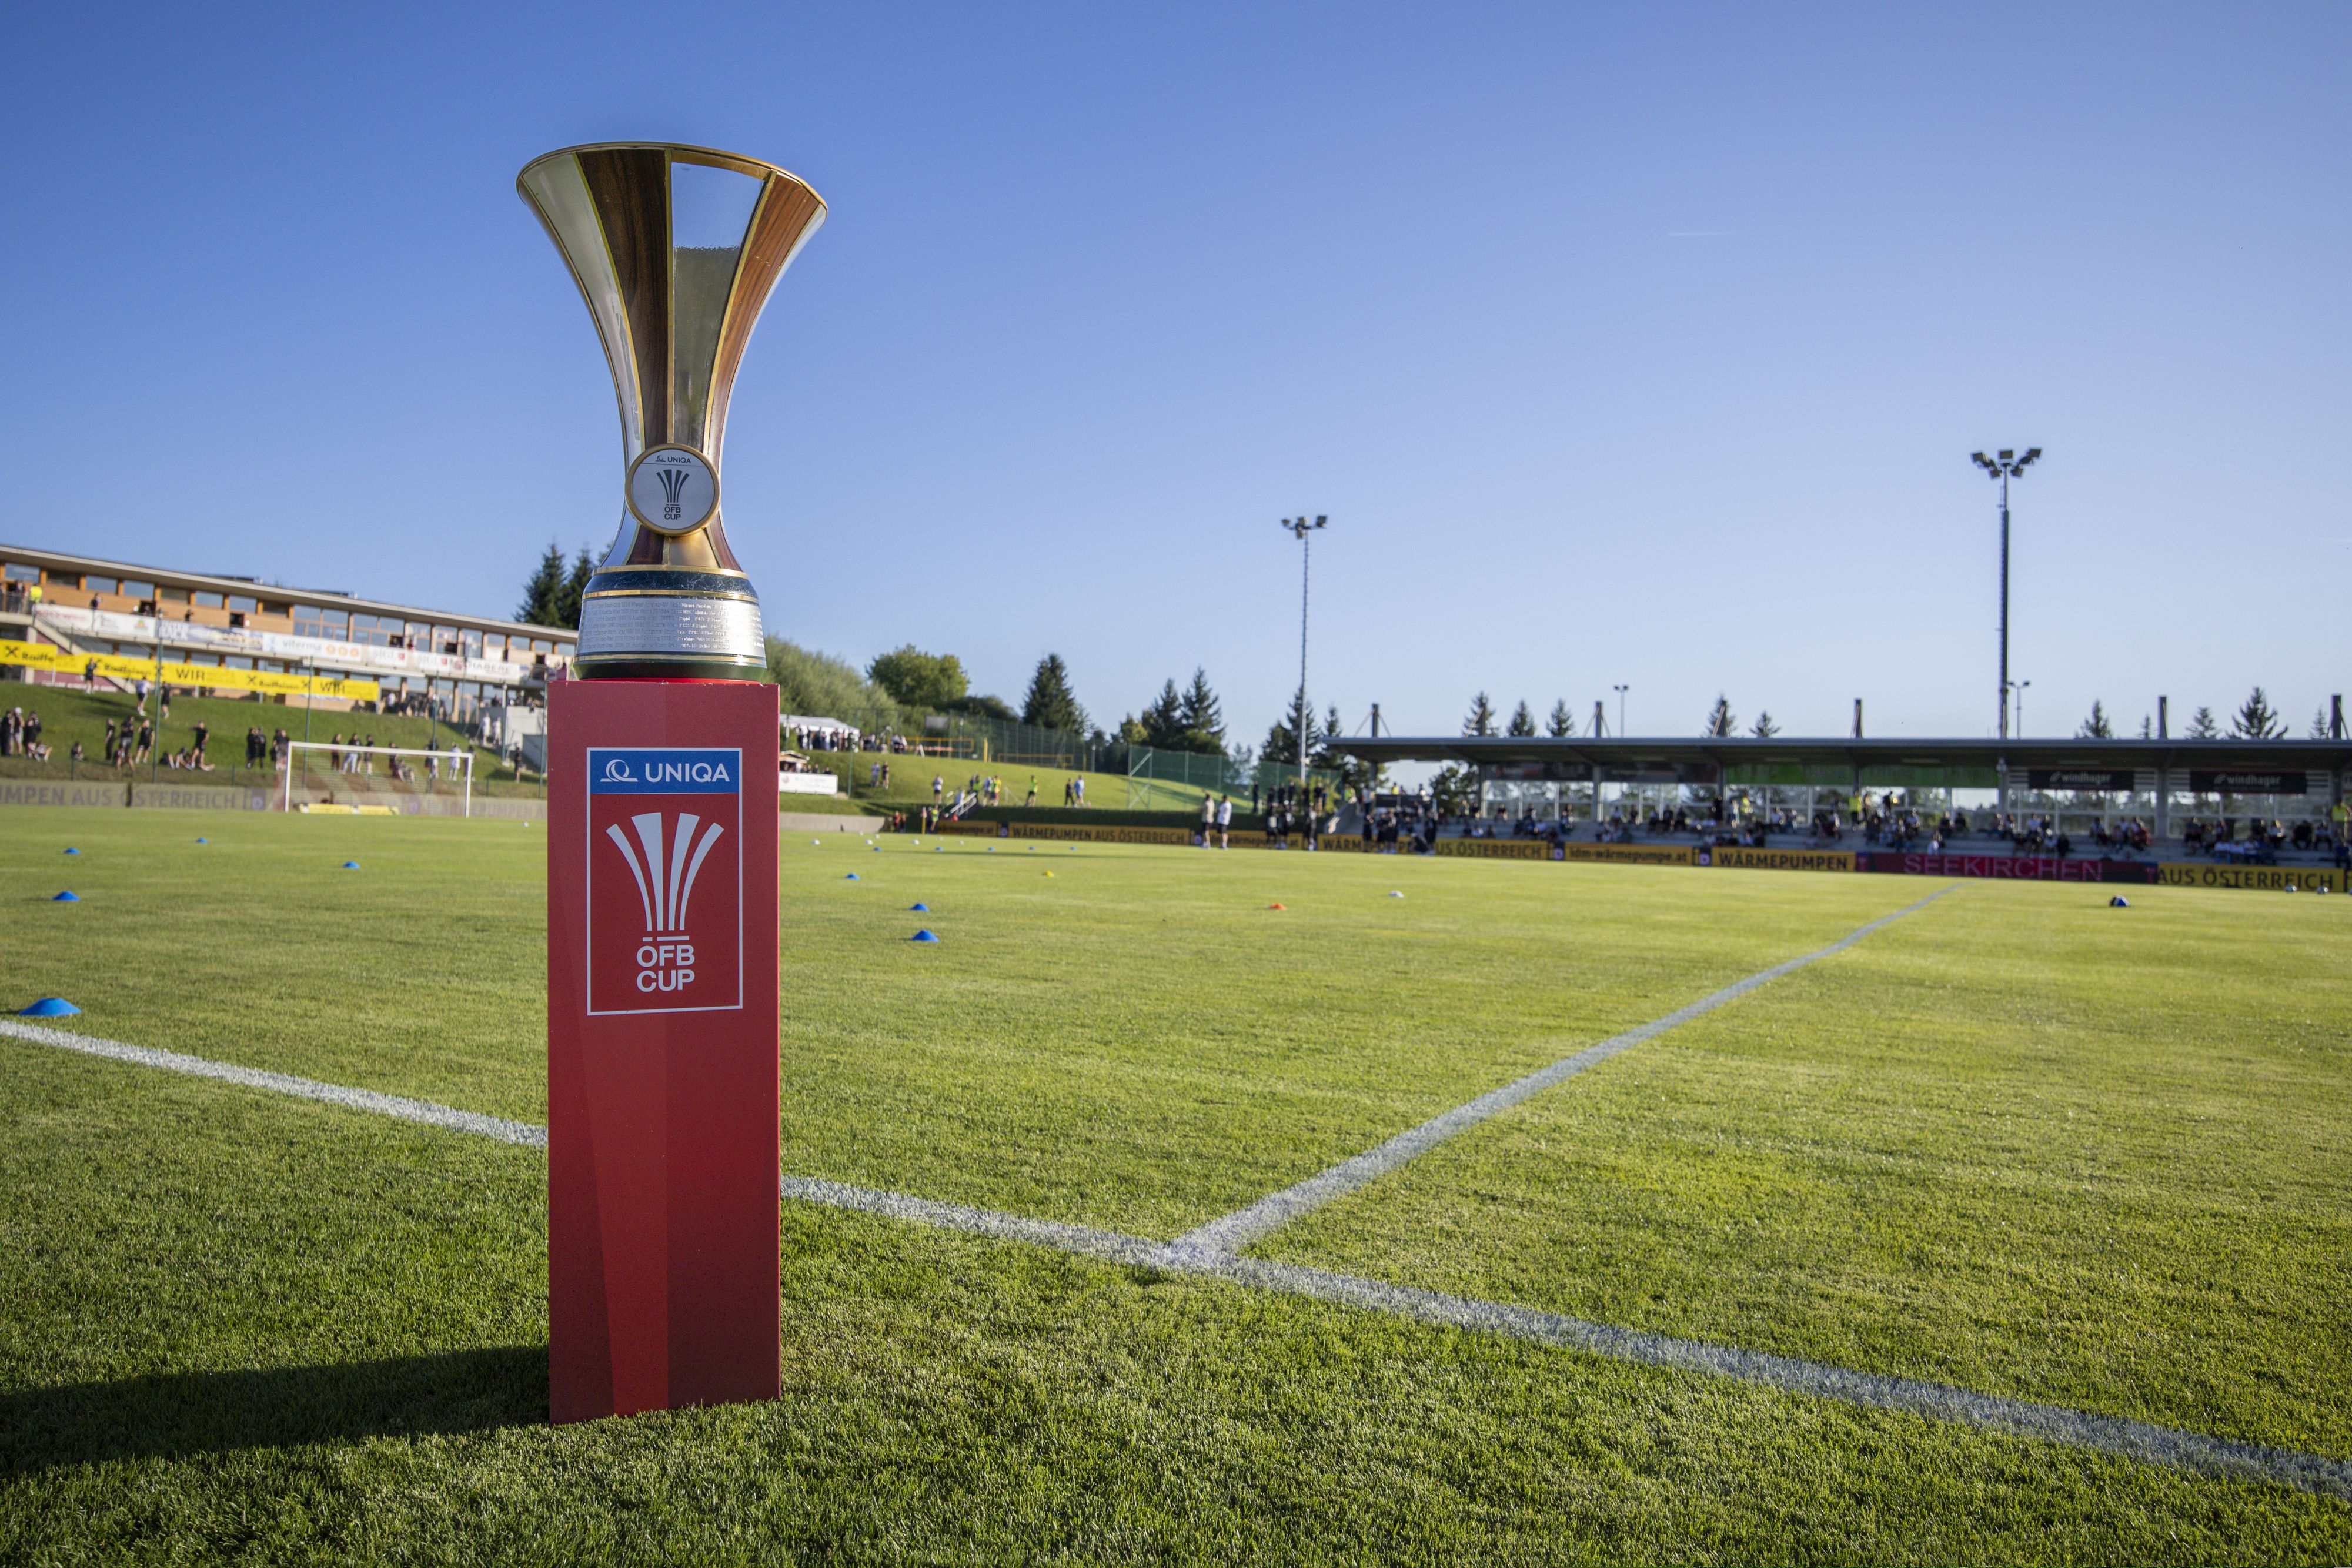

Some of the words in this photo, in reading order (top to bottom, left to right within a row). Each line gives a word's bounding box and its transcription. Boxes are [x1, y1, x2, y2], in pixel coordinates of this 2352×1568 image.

[176, 668, 205, 681] WIR
[645, 763, 730, 783] UNIQA
[2227, 773, 2282, 787] windhager
[0, 785, 65, 805] MPEN
[72, 788, 112, 806] AUS
[1013, 825, 1092, 840] WÄRMEPUMPEN
[1094, 829, 1115, 841] AUS
[1118, 828, 1185, 844] ÖSTERREICH
[1435, 842, 1453, 855] US
[1456, 840, 1541, 858] ÖSTERREICH
[1719, 850, 1847, 870] WÄRMEPUMPEN
[1903, 854, 2103, 881] SEEKIRCHEN
[2157, 868, 2195, 884] AUS
[2203, 867, 2333, 891] ÖSTERREICH
[636, 969, 696, 992] CUP
